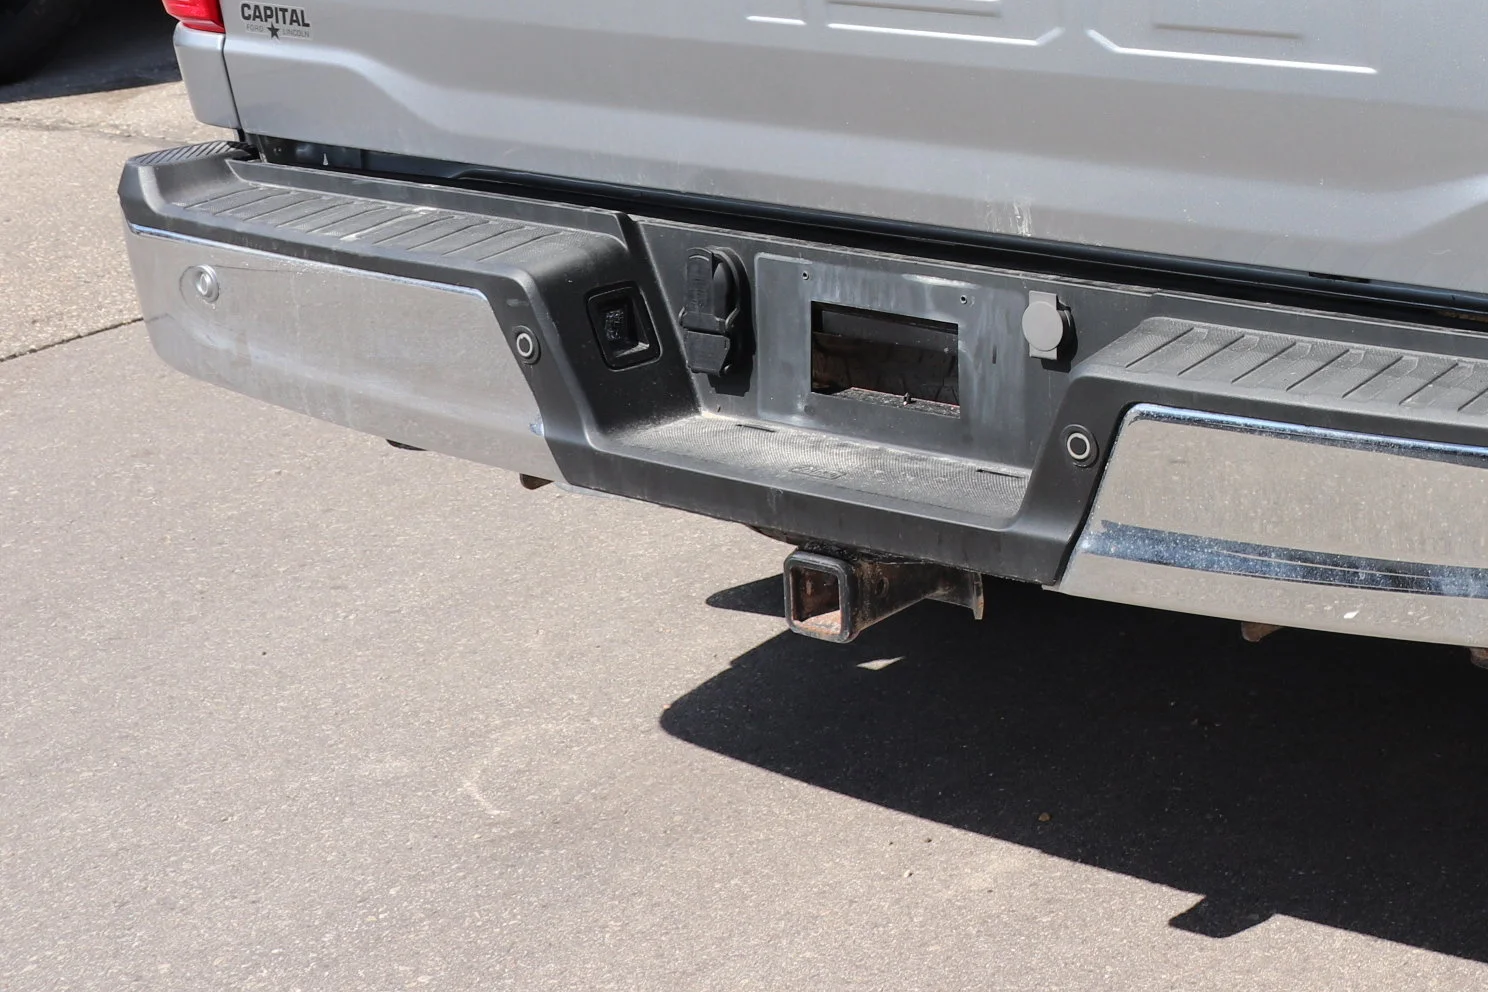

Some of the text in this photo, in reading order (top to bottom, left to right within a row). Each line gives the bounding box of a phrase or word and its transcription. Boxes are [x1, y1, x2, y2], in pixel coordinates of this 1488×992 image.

[241, 3, 310, 27] CAPITAL
[246, 23, 310, 38] FORD LINCOLN
